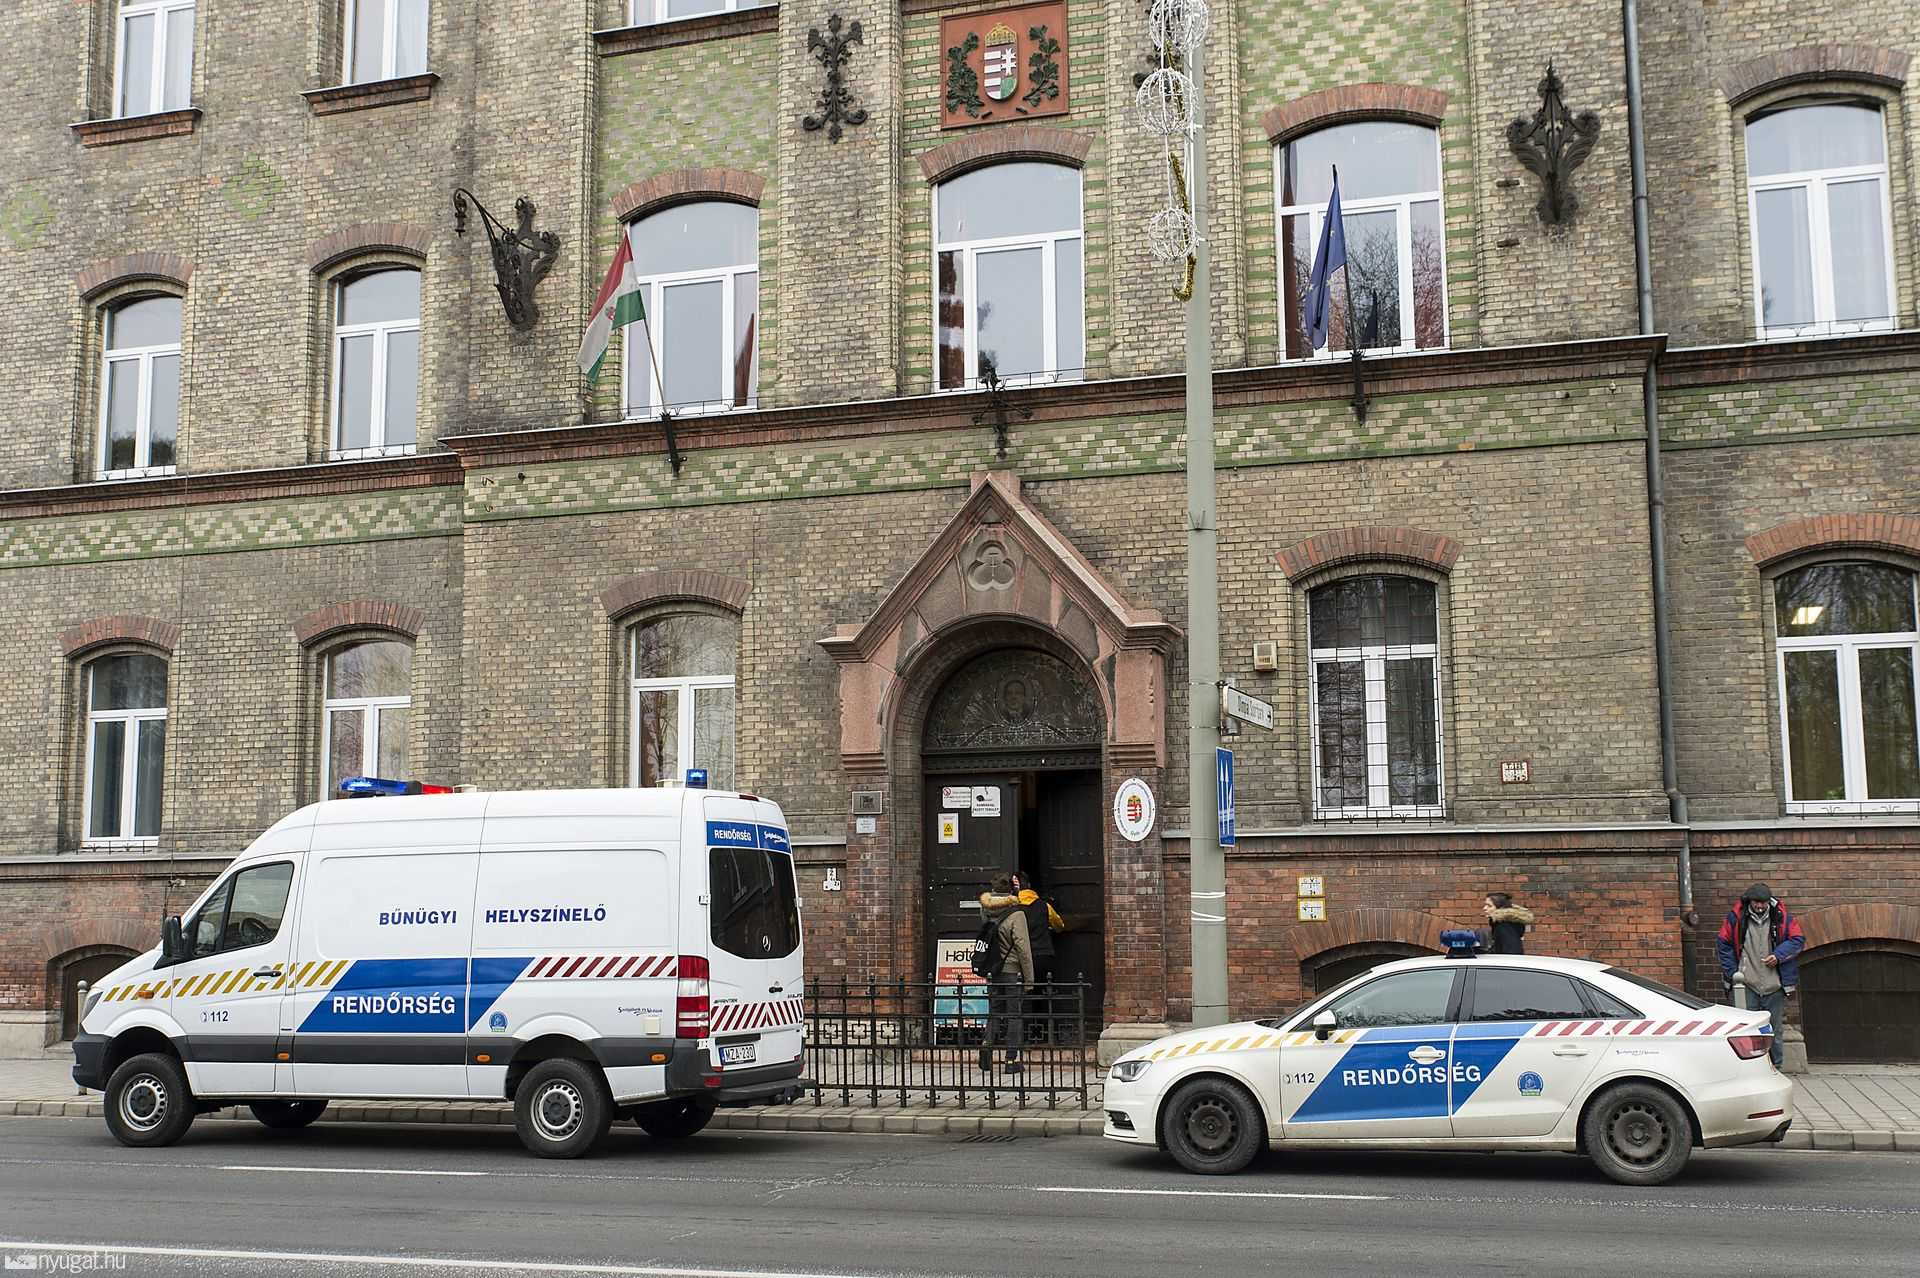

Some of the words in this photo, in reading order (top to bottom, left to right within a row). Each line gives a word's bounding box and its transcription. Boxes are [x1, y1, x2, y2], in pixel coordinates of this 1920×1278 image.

[714, 829, 752, 841] RENDŐRSÉG
[379, 908, 457, 925] BŰNÜGYI
[485, 904, 607, 923] HELYSZÍNELŐ
[333, 992, 455, 1014] RENDŐRSÉG
[210, 1011, 229, 1022] 112
[725, 1046, 754, 1061] MZA-230
[1294, 1073, 1316, 1084] 112
[1343, 1061, 1481, 1086] RENDŐRSÉG
